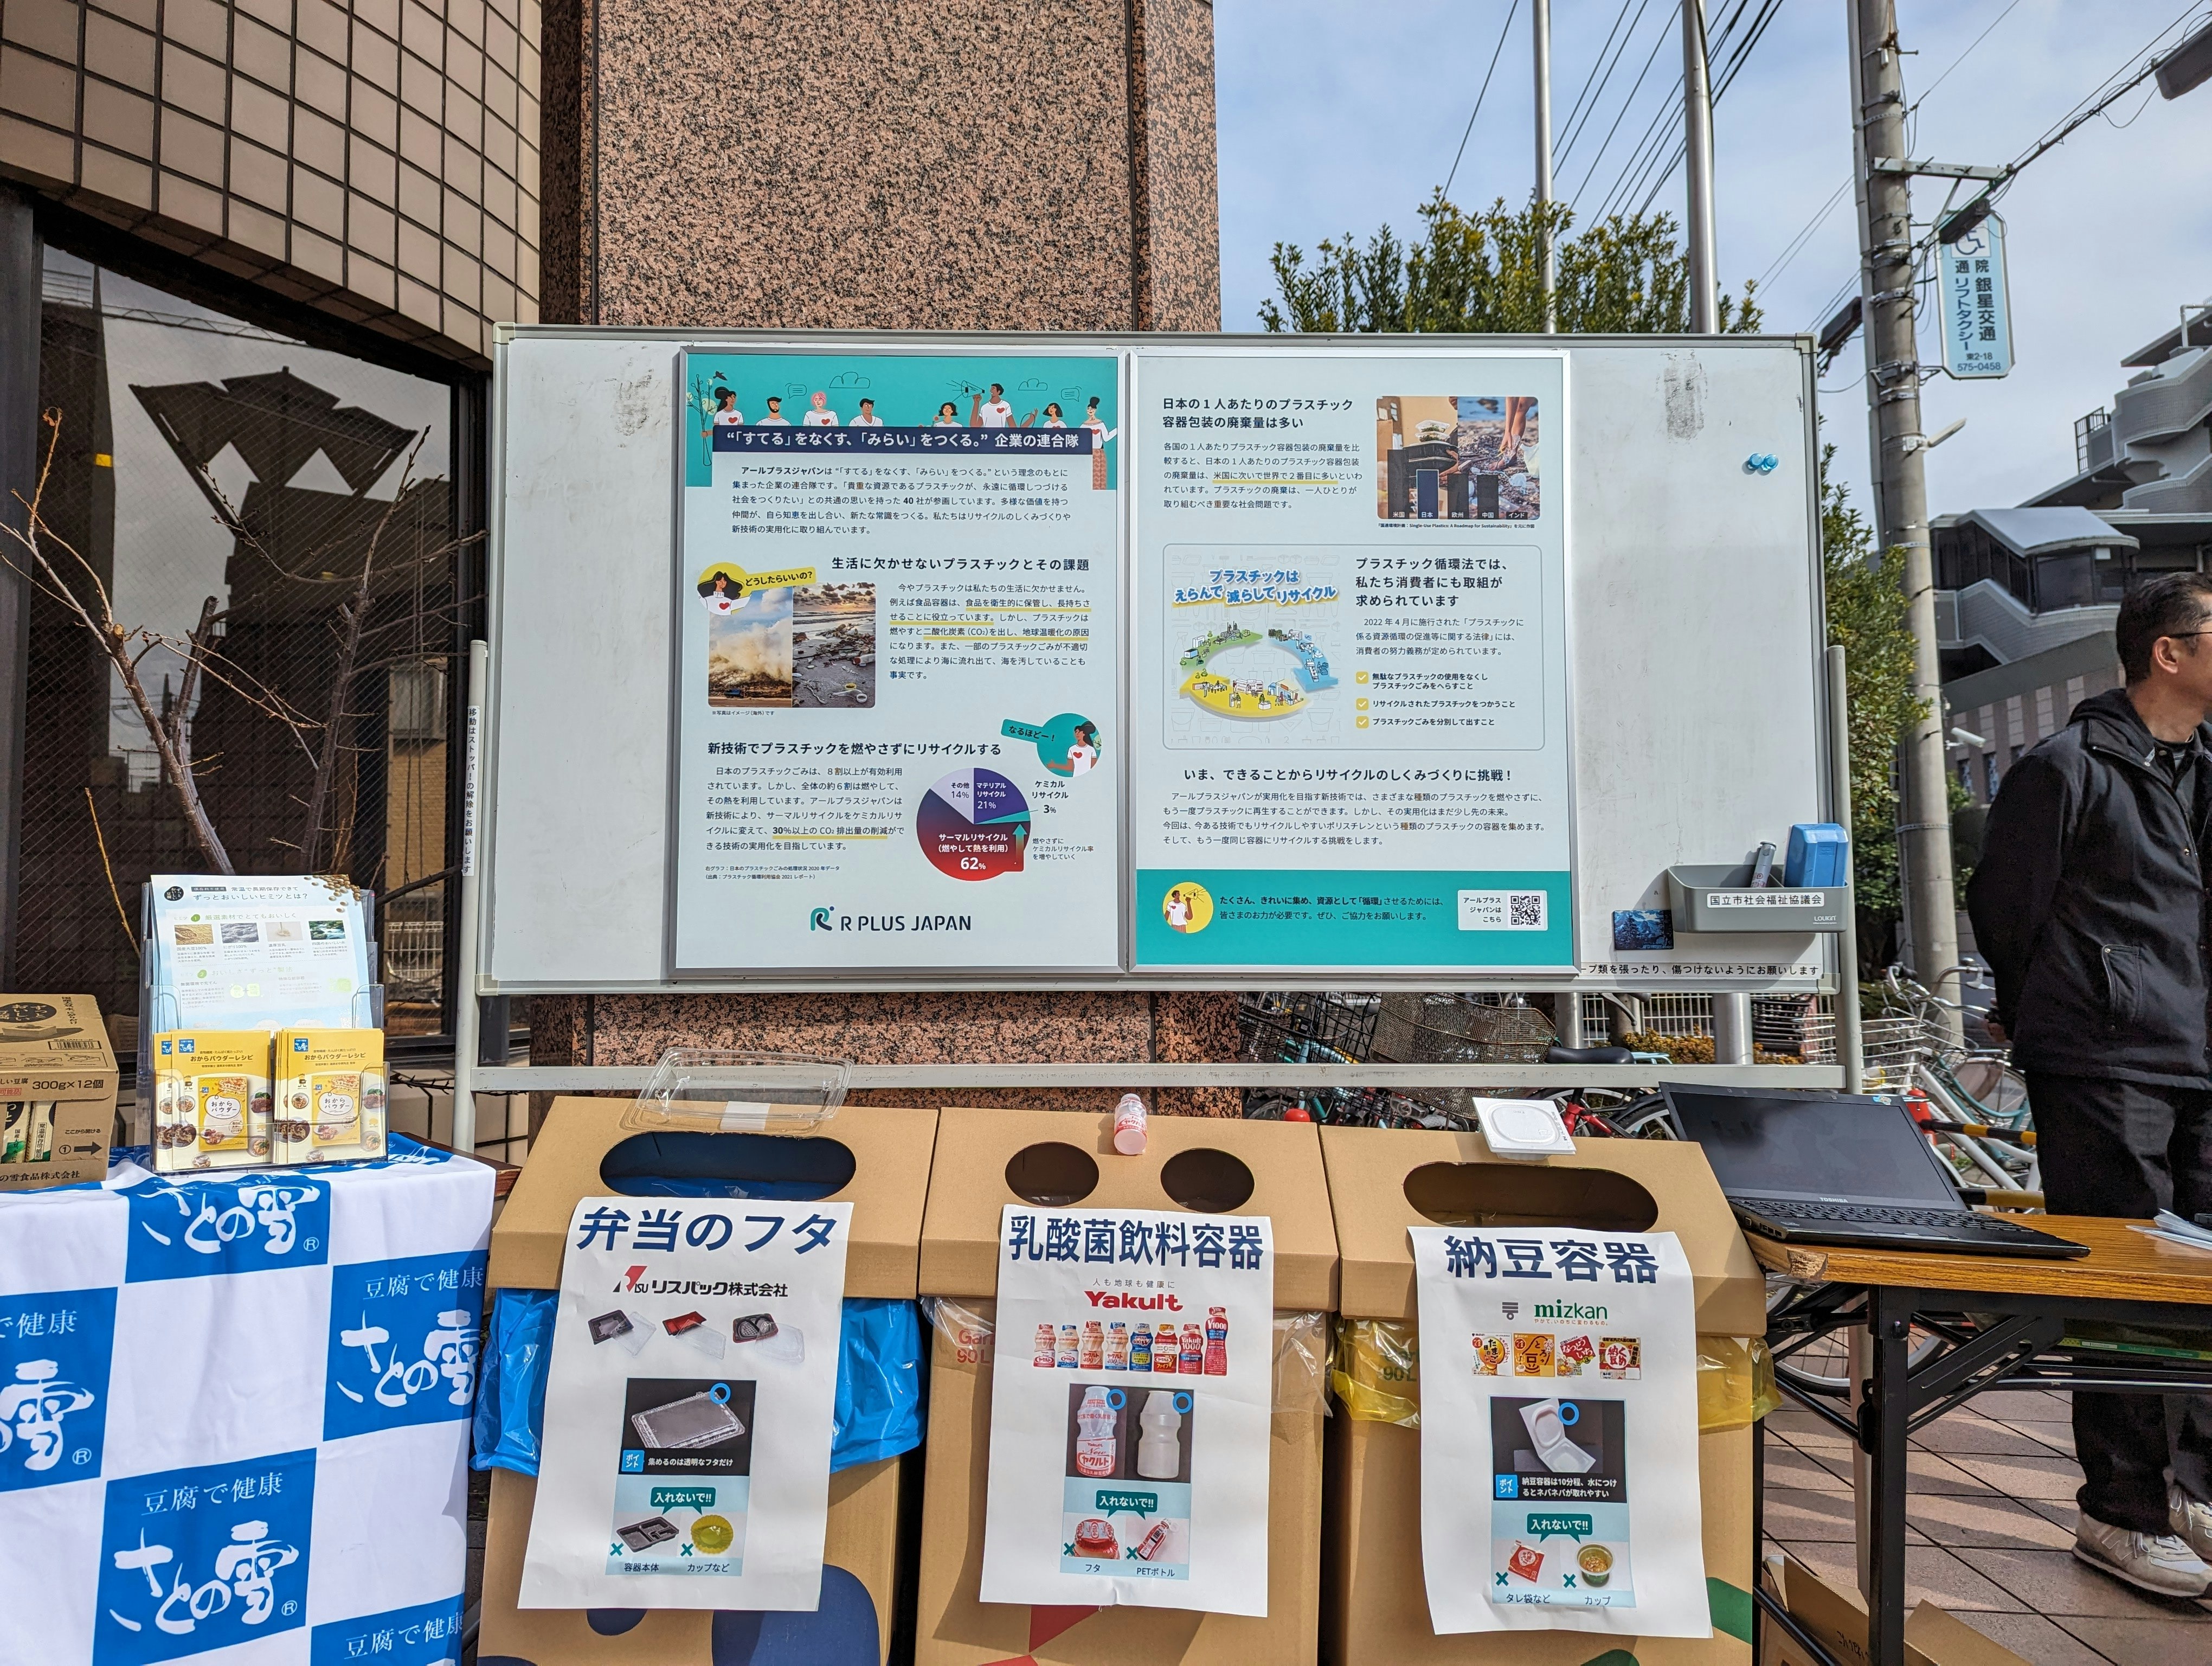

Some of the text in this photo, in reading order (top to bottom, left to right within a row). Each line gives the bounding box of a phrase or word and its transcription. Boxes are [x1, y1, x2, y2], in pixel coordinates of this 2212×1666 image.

[1956, 278, 1973, 350] リフトタクシー
[1976, 277, 1996, 341] 銀星交通
[1163, 398, 1354, 411] 日本の1人あたりのプラスチック
[1162, 415, 1304, 429] 容器包装の廃棄量は多い
[732, 482, 1068, 490] 集まった企業の連合隊です。「貴重な資源であるプラスチックが、永遠に循環しつづける
[1163, 486, 1357, 495] れています。プラスチックの廃棄は、一人ひとりが
[1163, 499, 1294, 509] 取り組むべき重要な社会問題です。
[732, 510, 1071, 521] 仲間が、自ら知恵を出し合い、新たな常識をつくる。私たちはリサイクルのしくみづくりや
[732, 525, 871, 534] 新技術の実用化に取り組んでいます。
[832, 557, 1089, 571] 生活に欠かせないプラスチックとその課題
[1356, 558, 1508, 571] プラスチック循環法では、
[745, 571, 813, 587] どうしたらいいの?
[1210, 570, 1298, 584] プラスチックは
[1356, 576, 1502, 589] 私たち消費者にも取組が
[898, 584, 1086, 593] 今やプラスチックは私たちの生活に欠かせません。
[1175, 585, 1337, 604] えらんで 減らして リサイクル
[889, 598, 1090, 608] 例えば食品容器は、食品を衛生的に保管し、長持ちさ
[1356, 594, 1459, 607] 求められています
[890, 613, 1089, 623] せることに役立っています。しかし、プラスチックは
[1356, 632, 1516, 641] 係る資源循環の促進等に関する法律」には、
[890, 642, 1088, 651] になります。また、一部のプラスチックごみが不適切
[1356, 647, 1502, 656] 消費者の努力義務が定められています。
[890, 656, 1085, 665] な処理により海に流れ出て、海を汚していることも
[889, 671, 928, 680] 事実です。
[1373, 700, 1516, 708] リサイクルされたプラスチックをつかうこと
[1373, 718, 1495, 726] プラスチックごみを分別して出すこと
[708, 742, 1001, 756] 新技術でプラスチックを燃やさずにリサイクルする
[1185, 768, 1512, 782] いま、できることからリサイクルのしくみづくりに挑戦！
[1035, 780, 1065, 789] ケミカル
[464, 708, 477, 874] 移動はストッパーの解除をお願いします
[951, 791, 969, 799] 14%
[1032, 791, 1069, 799] リサイクル
[706, 797, 902, 806] その熱を利用しています。アールプラスジャパンは
[1172, 792, 1543, 802] アールプラスジャパンが実用化を目指す新技術では、さまざまな種類のプラスチックを燃やさずに、
[978, 800, 996, 810] 21%
[1044, 804, 1056, 814] 3%
[706, 811, 902, 821] 新技術により、サーマルリサイクルをケミカルリサ
[1162, 807, 1510, 816] もう一度プラスチックに再生することができます。しかし、その実用化はまだ少し先の未来。
[1162, 822, 1546, 831] 今回は、今ある技術でもリサイクルしやすいポリスチレンという種類のプラスチックの容器を集めます。
[938, 834, 1008, 842] サーマルリサイクル
[1162, 836, 1384, 845] そして、もう一度同じ容器にリサイクルする挑戦をします。
[706, 842, 847, 851] きる技術の実用化を目指しています。
[961, 857, 986, 871] 62%
[1220, 896, 1444, 906] たくさん、きれいに集め、資源として「循環」させるためには、
[1711, 895, 1822, 905] 国立市社会福祉協議会
[1220, 911, 1427, 920] 皆さまのお力が必要です。ぜひ、ご協力をお願いします。
[841, 916, 971, 931] R PLUS JAPAN
[576, 1207, 837, 1254] 弁当のフタ
[1008, 1215, 1263, 1271] 乳酸菌飲料容器
[1444, 1235, 1659, 1283] 納豆容器
[363, 1266, 484, 1300] 豆腐で健康
[1092, 1278, 1175, 1289] 人も地球も健康に
[652, 1280, 788, 1298] リスパック株式会社
[1084, 1291, 1184, 1312] Yakult
[1534, 1299, 1608, 1319] mizkan
[648, 1457, 733, 1466] 集めるのは透明なフタだけ
[1082, 1457, 1109, 1466] ヤクルト
[1522, 1477, 1617, 1487] 納豆容器は10分程、水につけ
[141, 1472, 282, 1515] 豆腐で健康
[1523, 1488, 1609, 1497] るとネバネバが取れやすい
[624, 1563, 730, 1572] 容器本体 カップなど
[1085, 1564, 1175, 1577] フタ PETボトル
[109, 1521, 299, 1633] さとの雪
[1507, 1594, 1611, 1605] タレ袋など カップ
[344, 1611, 464, 1659] 豆腐で健康
